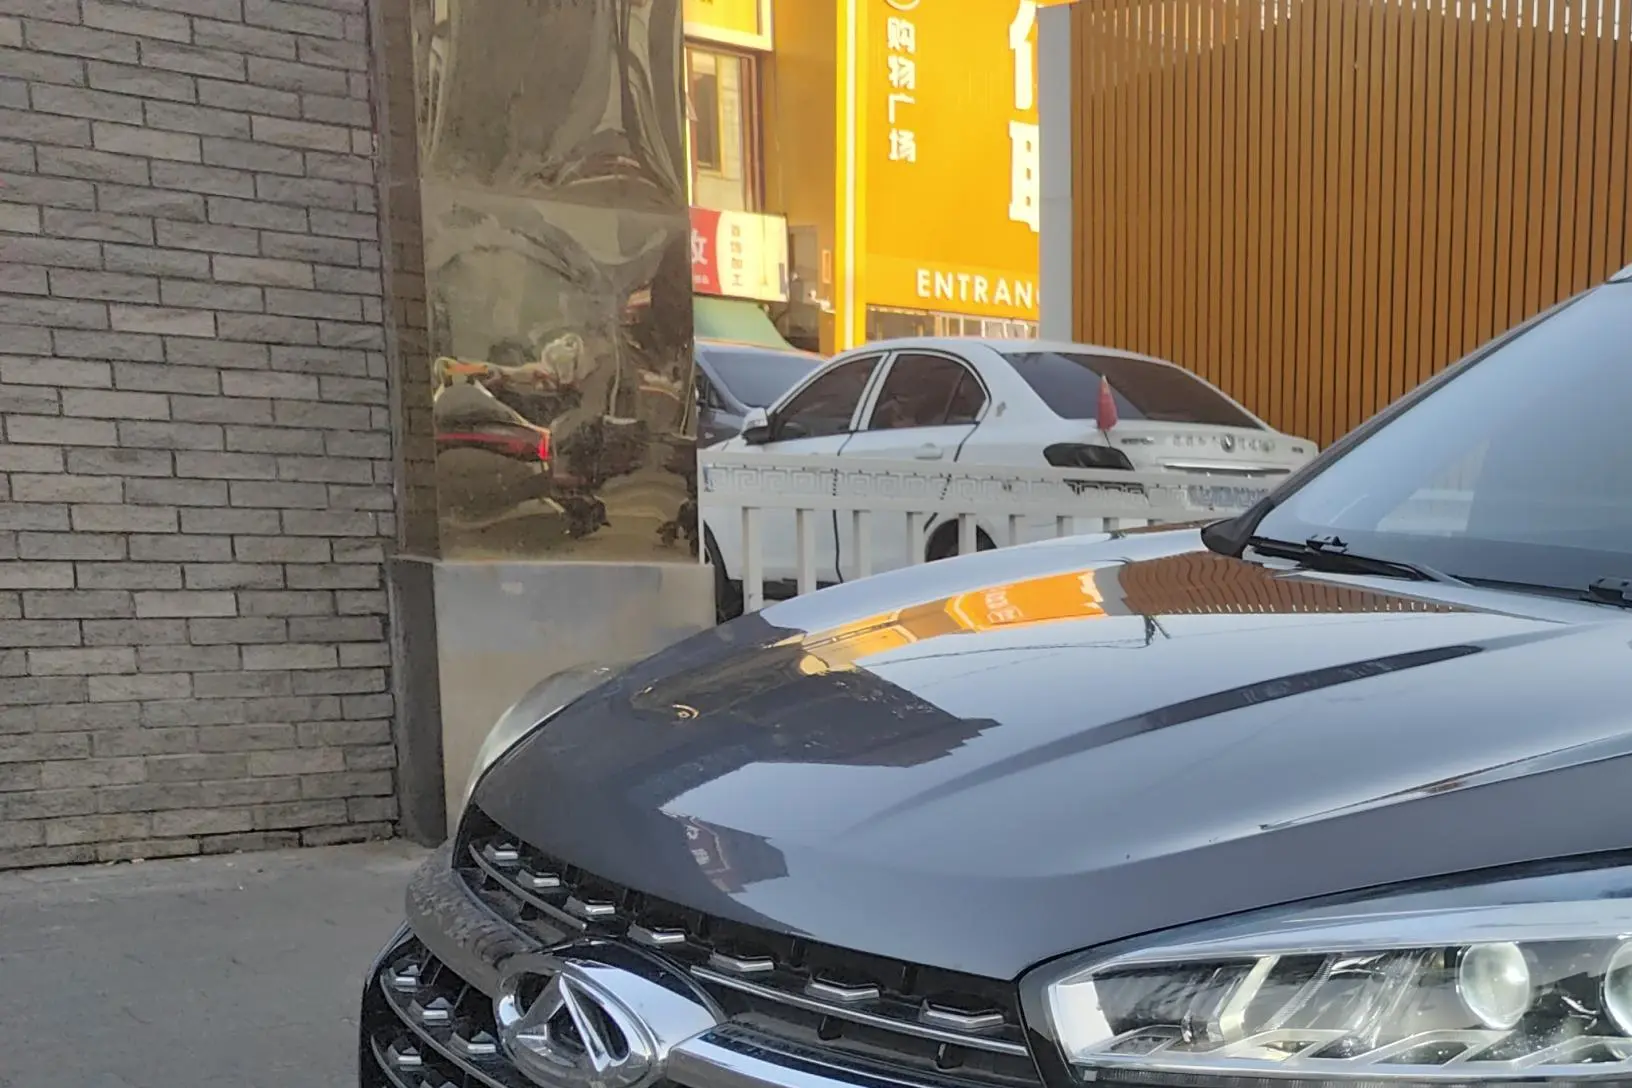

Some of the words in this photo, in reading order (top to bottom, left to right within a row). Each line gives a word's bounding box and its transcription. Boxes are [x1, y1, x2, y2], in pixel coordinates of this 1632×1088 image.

[887, 17, 916, 163] 购物广场
[916, 267, 1039, 309] ENTRAN
